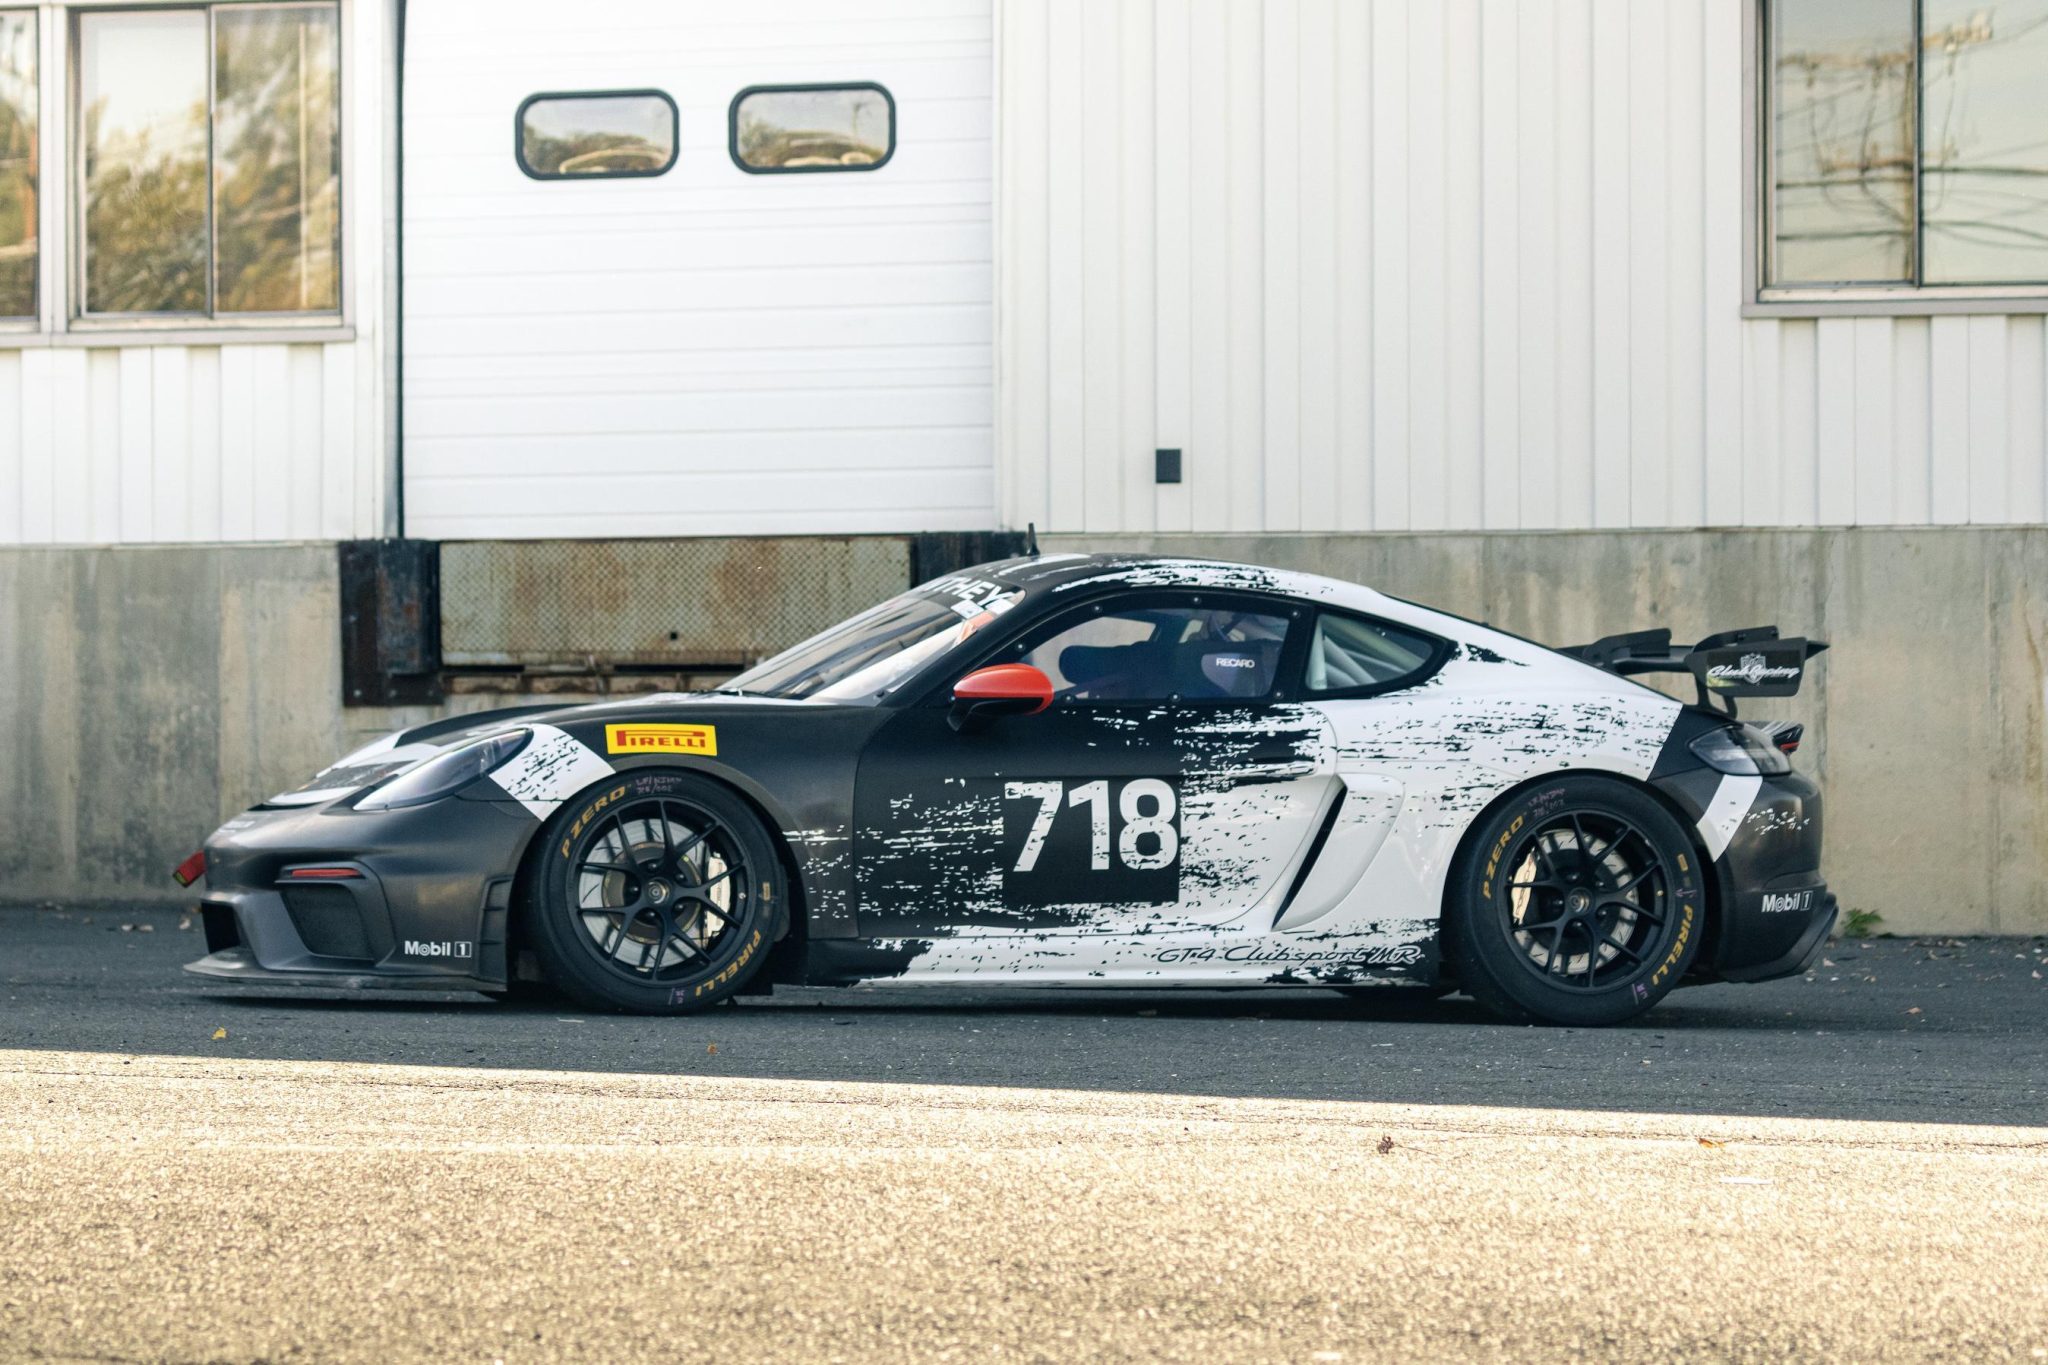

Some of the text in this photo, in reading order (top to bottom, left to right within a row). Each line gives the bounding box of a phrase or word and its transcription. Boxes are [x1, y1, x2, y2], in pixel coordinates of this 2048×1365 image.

[1216, 657, 1256, 669] RECARO
[616, 729, 706, 748] PIRELLI
[561, 786, 626, 859] P ZERO
[1004, 778, 1179, 872] 718
[1483, 815, 1524, 899] P ZERO
[1761, 892, 1801, 912] Mobil
[404, 940, 451, 957] Mobil
[695, 930, 761, 996] PIRELLI
[1157, 945, 1421, 967] GT4 Clubsport MR
[1652, 904, 1694, 986] PIRELLI
